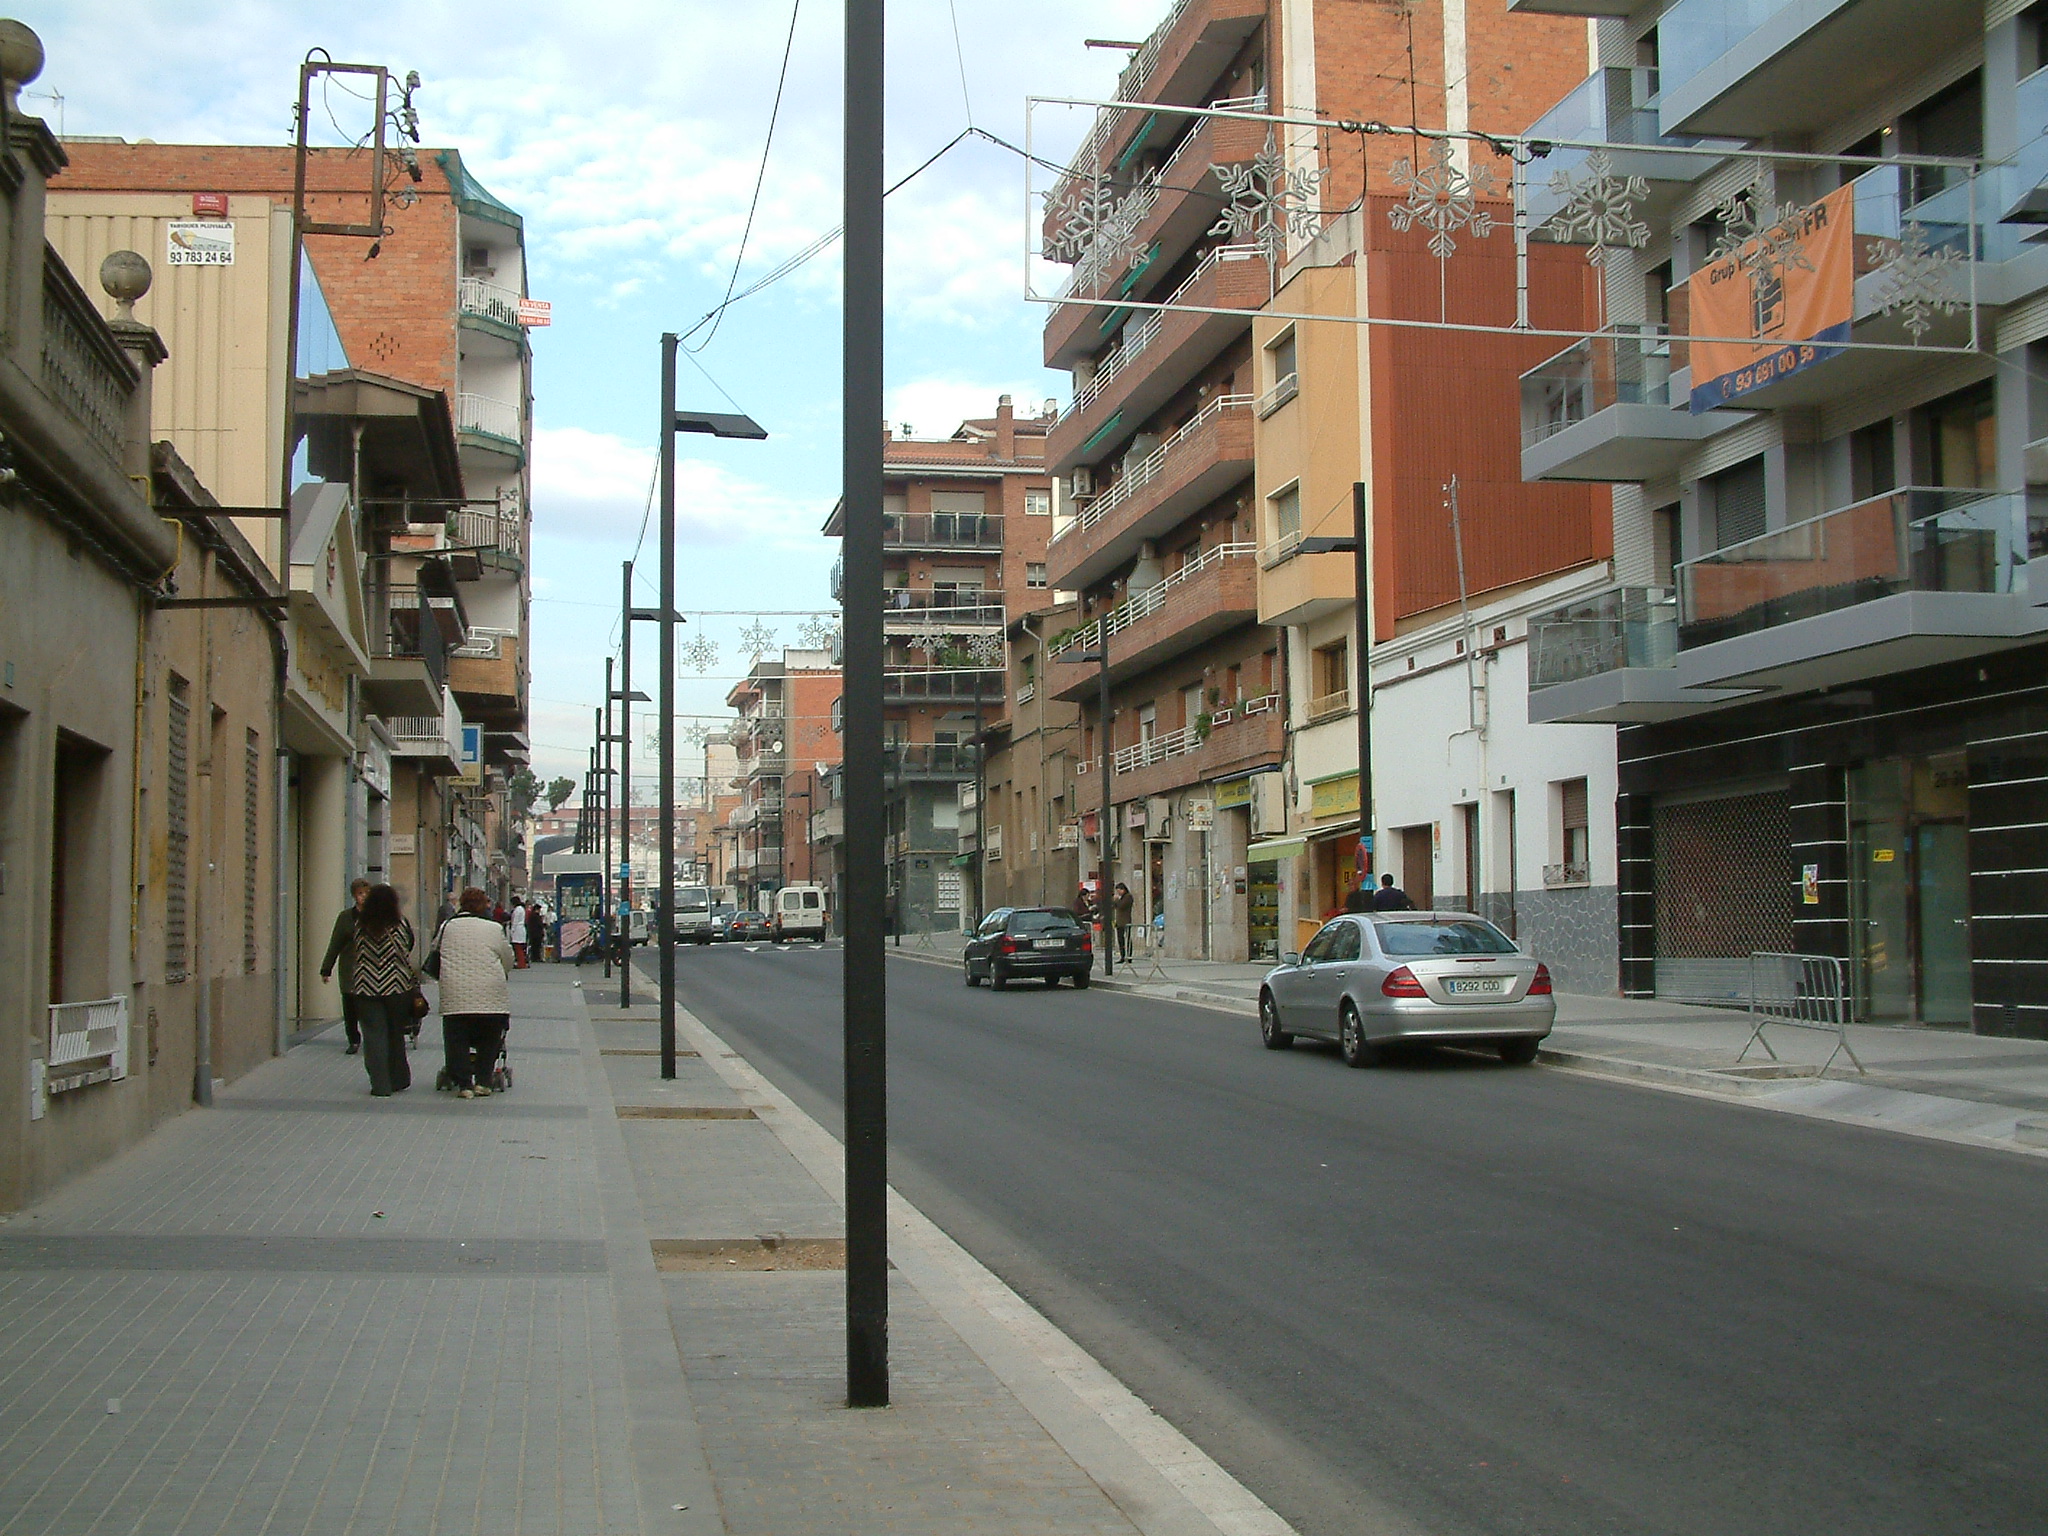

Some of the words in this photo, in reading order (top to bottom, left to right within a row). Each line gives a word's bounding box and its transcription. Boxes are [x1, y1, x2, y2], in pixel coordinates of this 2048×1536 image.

[170, 252, 182, 263] 93
[185, 252, 202, 263] 783
[205, 252, 216, 263] 24
[219, 252, 232, 263] 64
[1710, 261, 1735, 285] Grup
[1735, 370, 1753, 392] 93
[1778, 350, 1797, 373] 00
[1456, 981, 1480, 992] 8292
